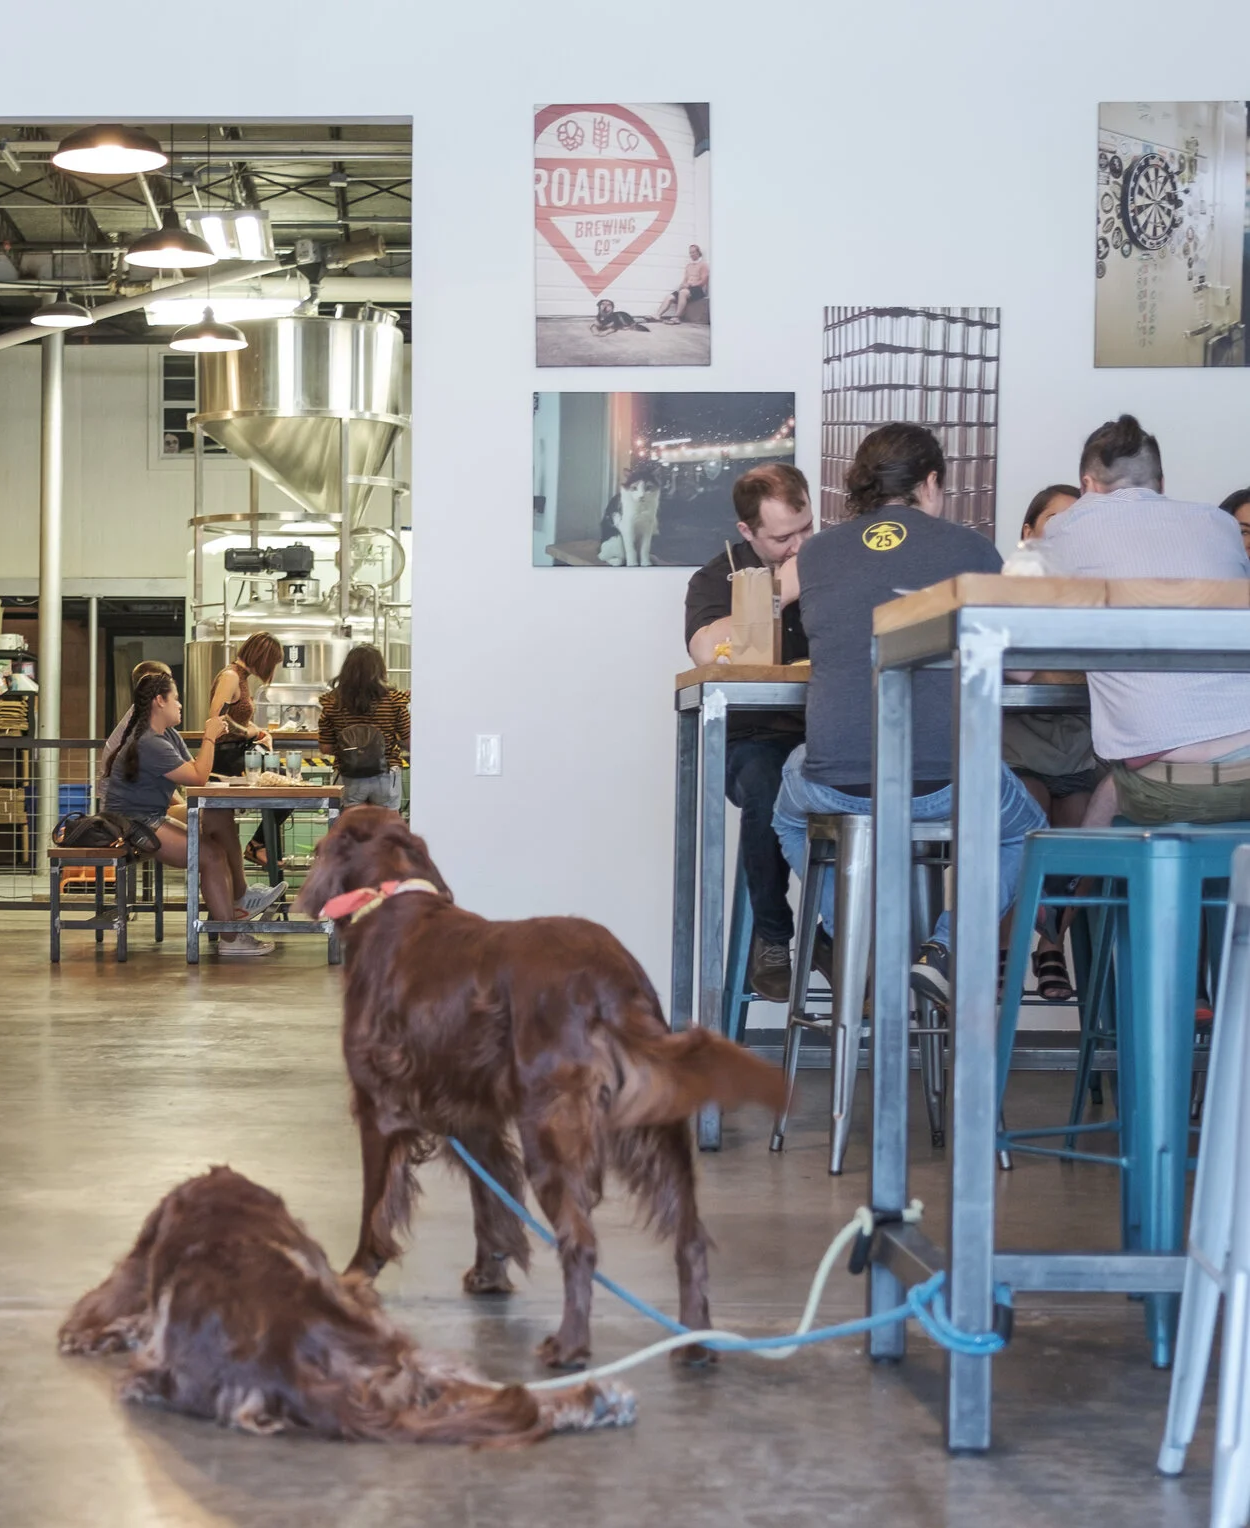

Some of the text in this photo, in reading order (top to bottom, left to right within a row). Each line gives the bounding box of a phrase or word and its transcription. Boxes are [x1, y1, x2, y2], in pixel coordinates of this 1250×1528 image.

[535, 168, 671, 206] ROADMAP
[575, 217, 636, 238] BREWING
[876, 534, 892, 548] 25
